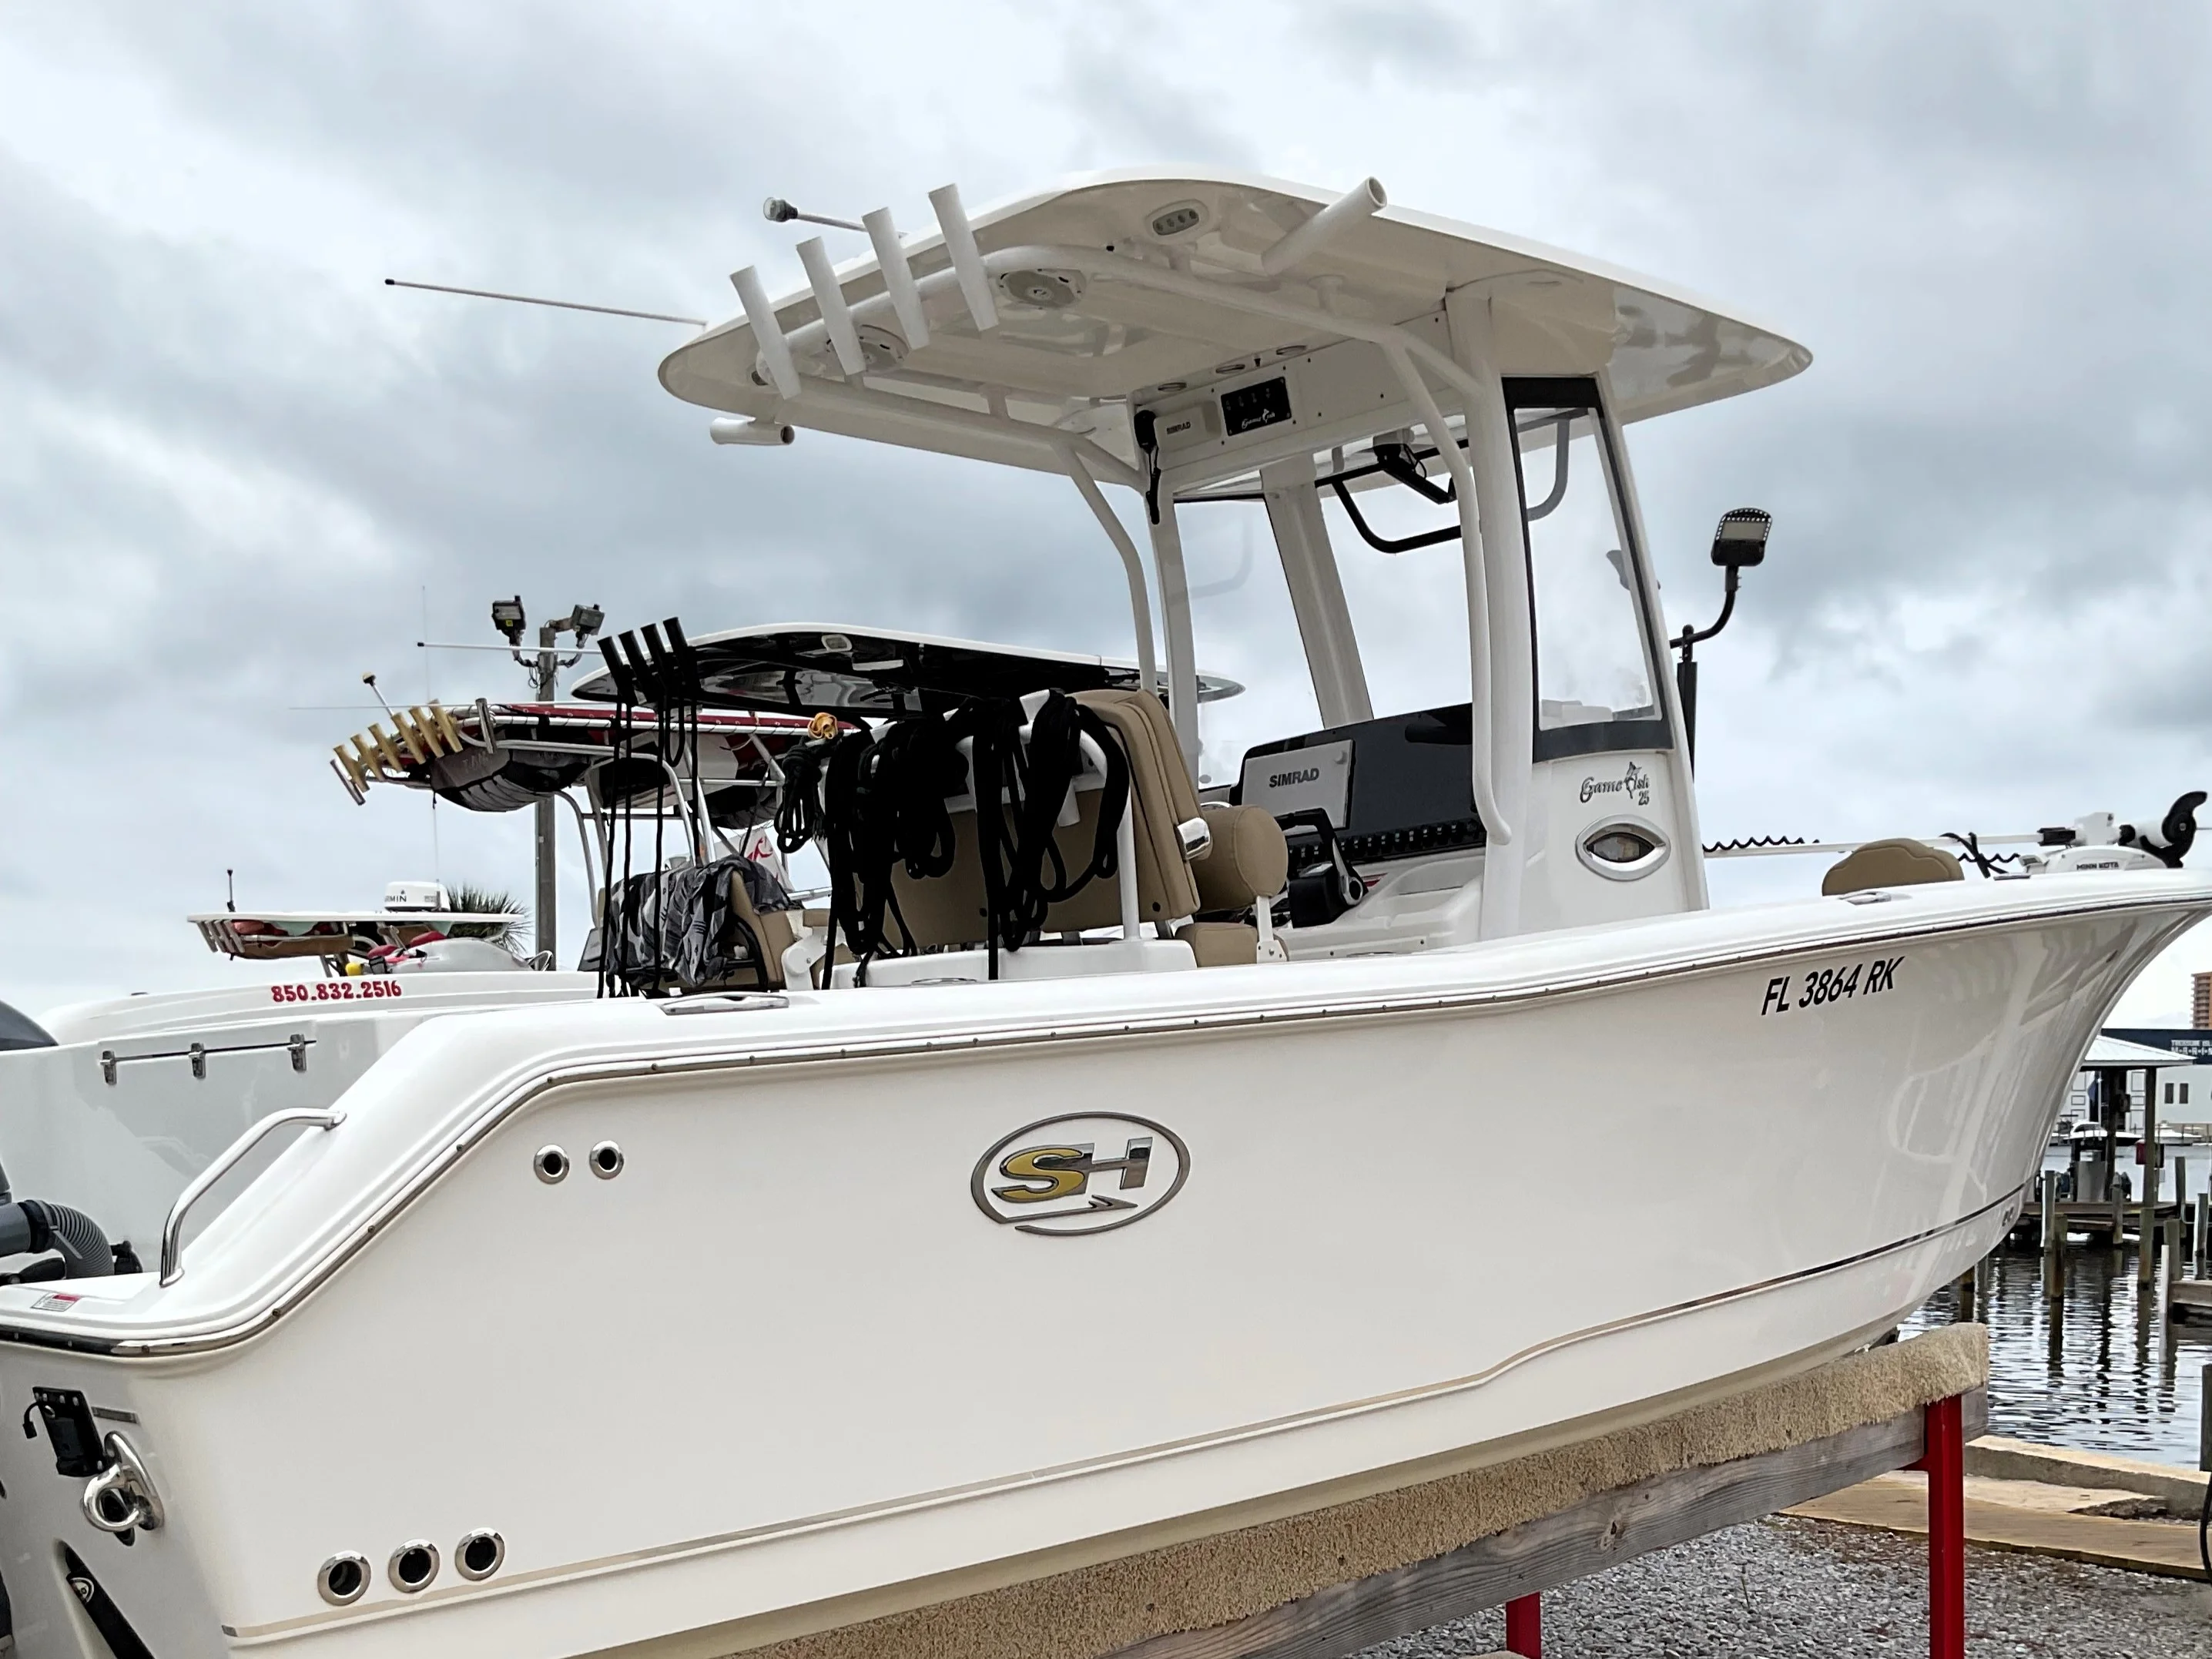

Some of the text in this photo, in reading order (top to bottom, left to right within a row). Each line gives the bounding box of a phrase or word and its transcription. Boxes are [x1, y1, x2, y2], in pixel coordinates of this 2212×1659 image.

[1269, 767, 1319, 788] SIMRAD
[1638, 790, 1650, 806] 25
[271, 980, 402, 1003] 850.832.2516
[1761, 956, 1905, 1016] FL 3864 RK
[991, 1137, 1153, 1204] SH
